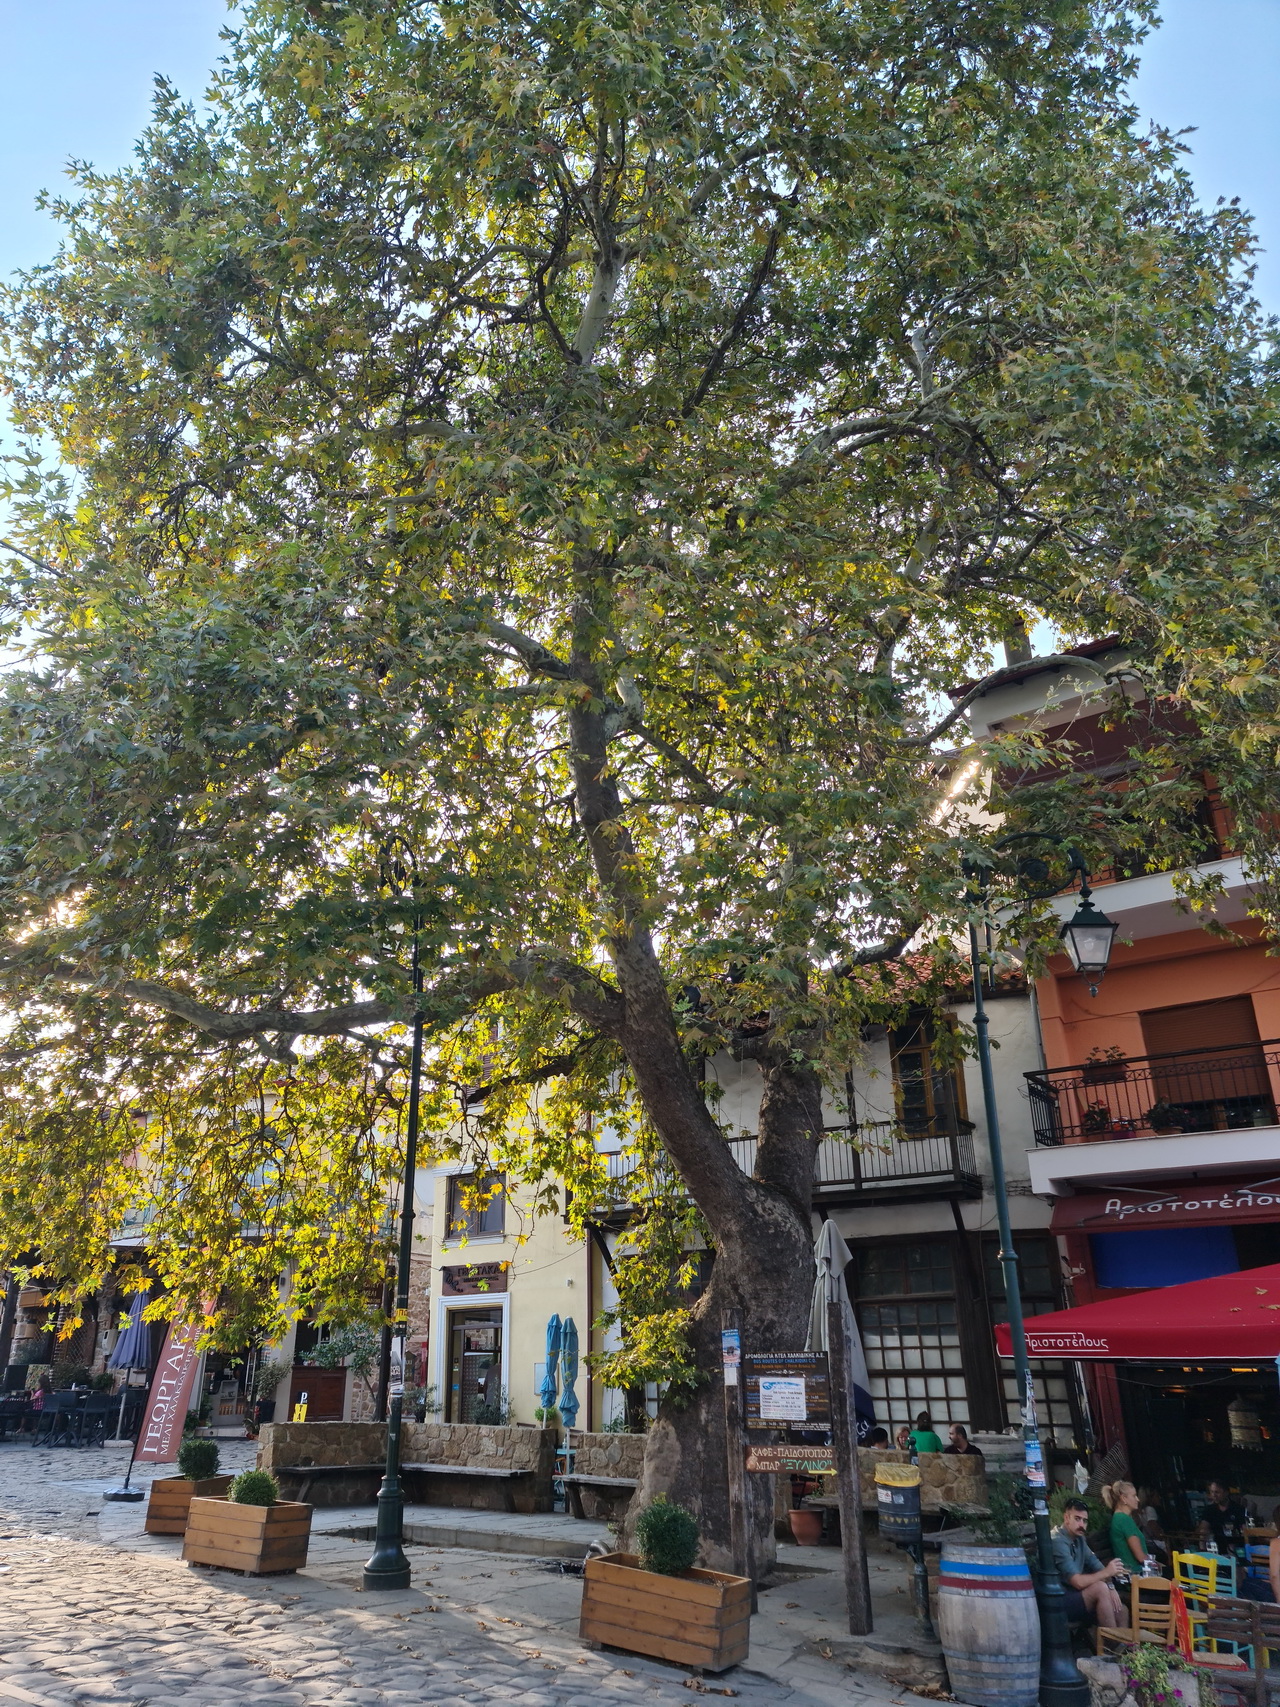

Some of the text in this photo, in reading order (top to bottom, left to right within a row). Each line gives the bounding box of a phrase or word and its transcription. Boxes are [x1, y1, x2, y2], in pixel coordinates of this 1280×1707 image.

[1105, 1193, 1280, 1220] Αριστοτέλο
[160, 1423, 173, 1455] ΜΕΛΙ
[756, 1461, 780, 1470] ΜΠΑΡ
